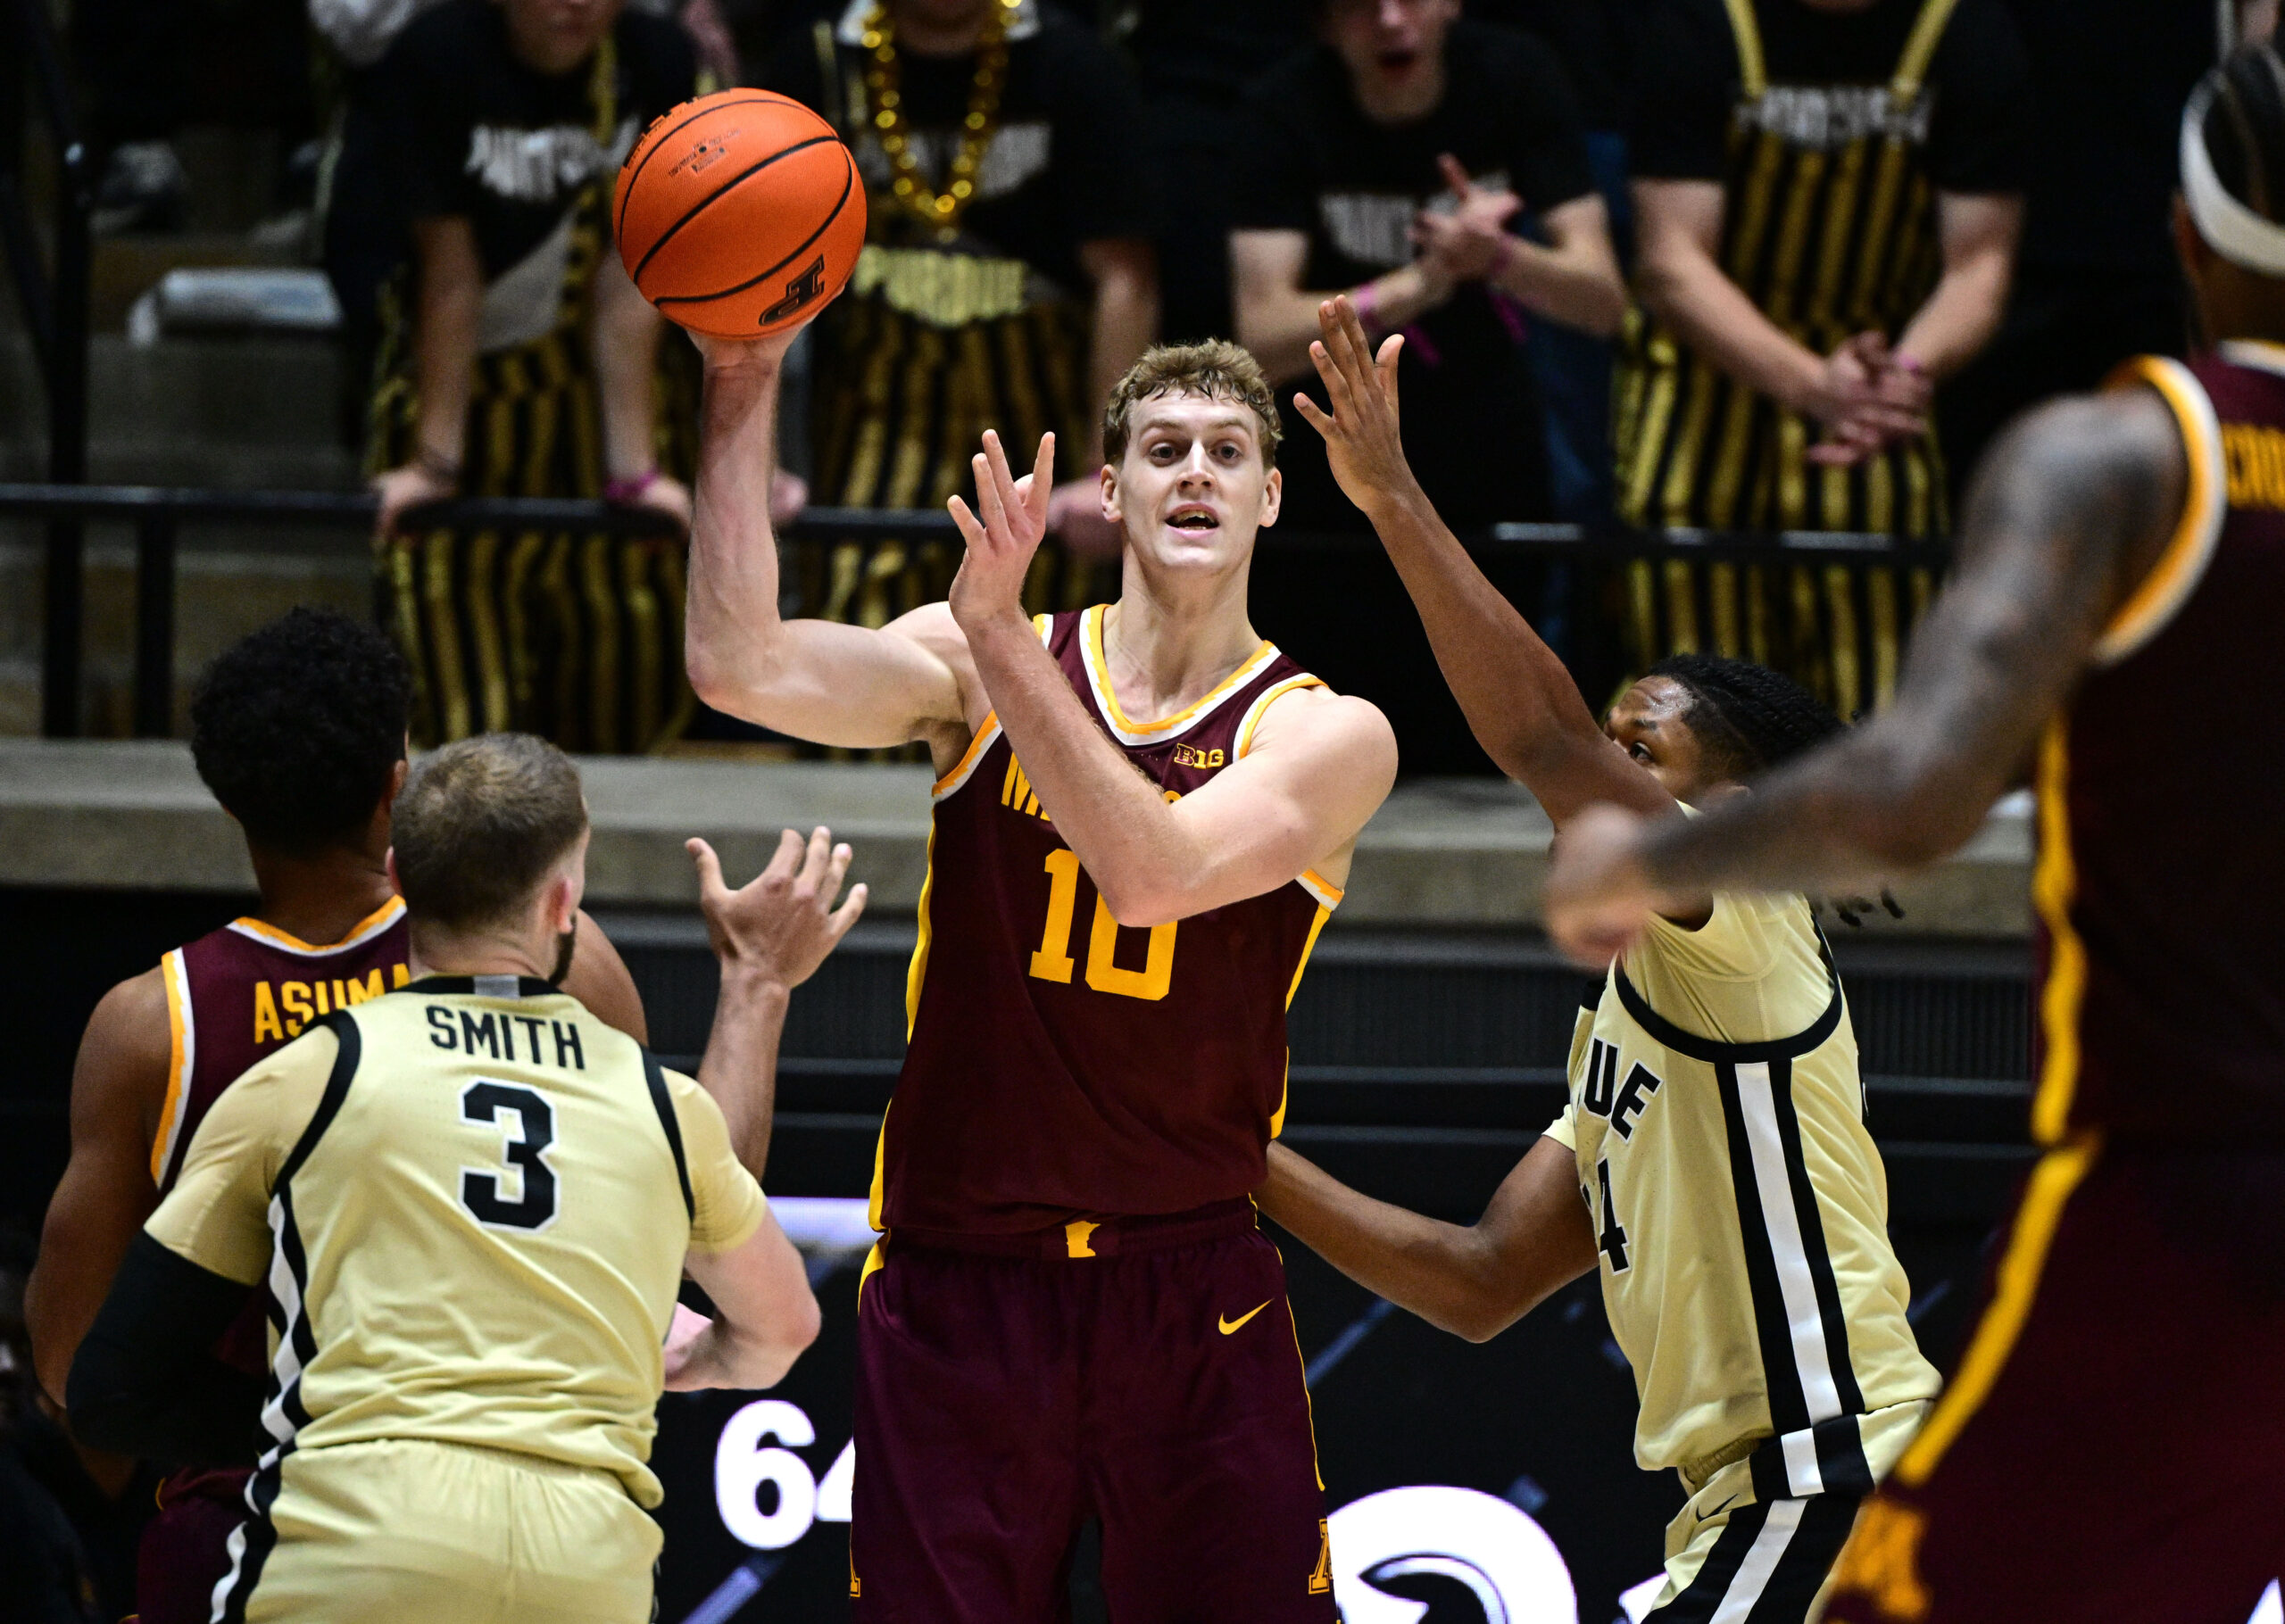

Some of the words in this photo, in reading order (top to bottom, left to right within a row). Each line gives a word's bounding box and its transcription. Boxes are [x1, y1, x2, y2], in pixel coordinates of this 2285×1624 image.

[1028, 848, 1178, 1001] 10
[253, 963, 411, 1045] ASUM
[425, 1005, 586, 1071] SMITH
[1576, 1035, 1665, 1145] UE
[458, 1076, 561, 1234] 3
[1580, 1154, 1632, 1276] 4
